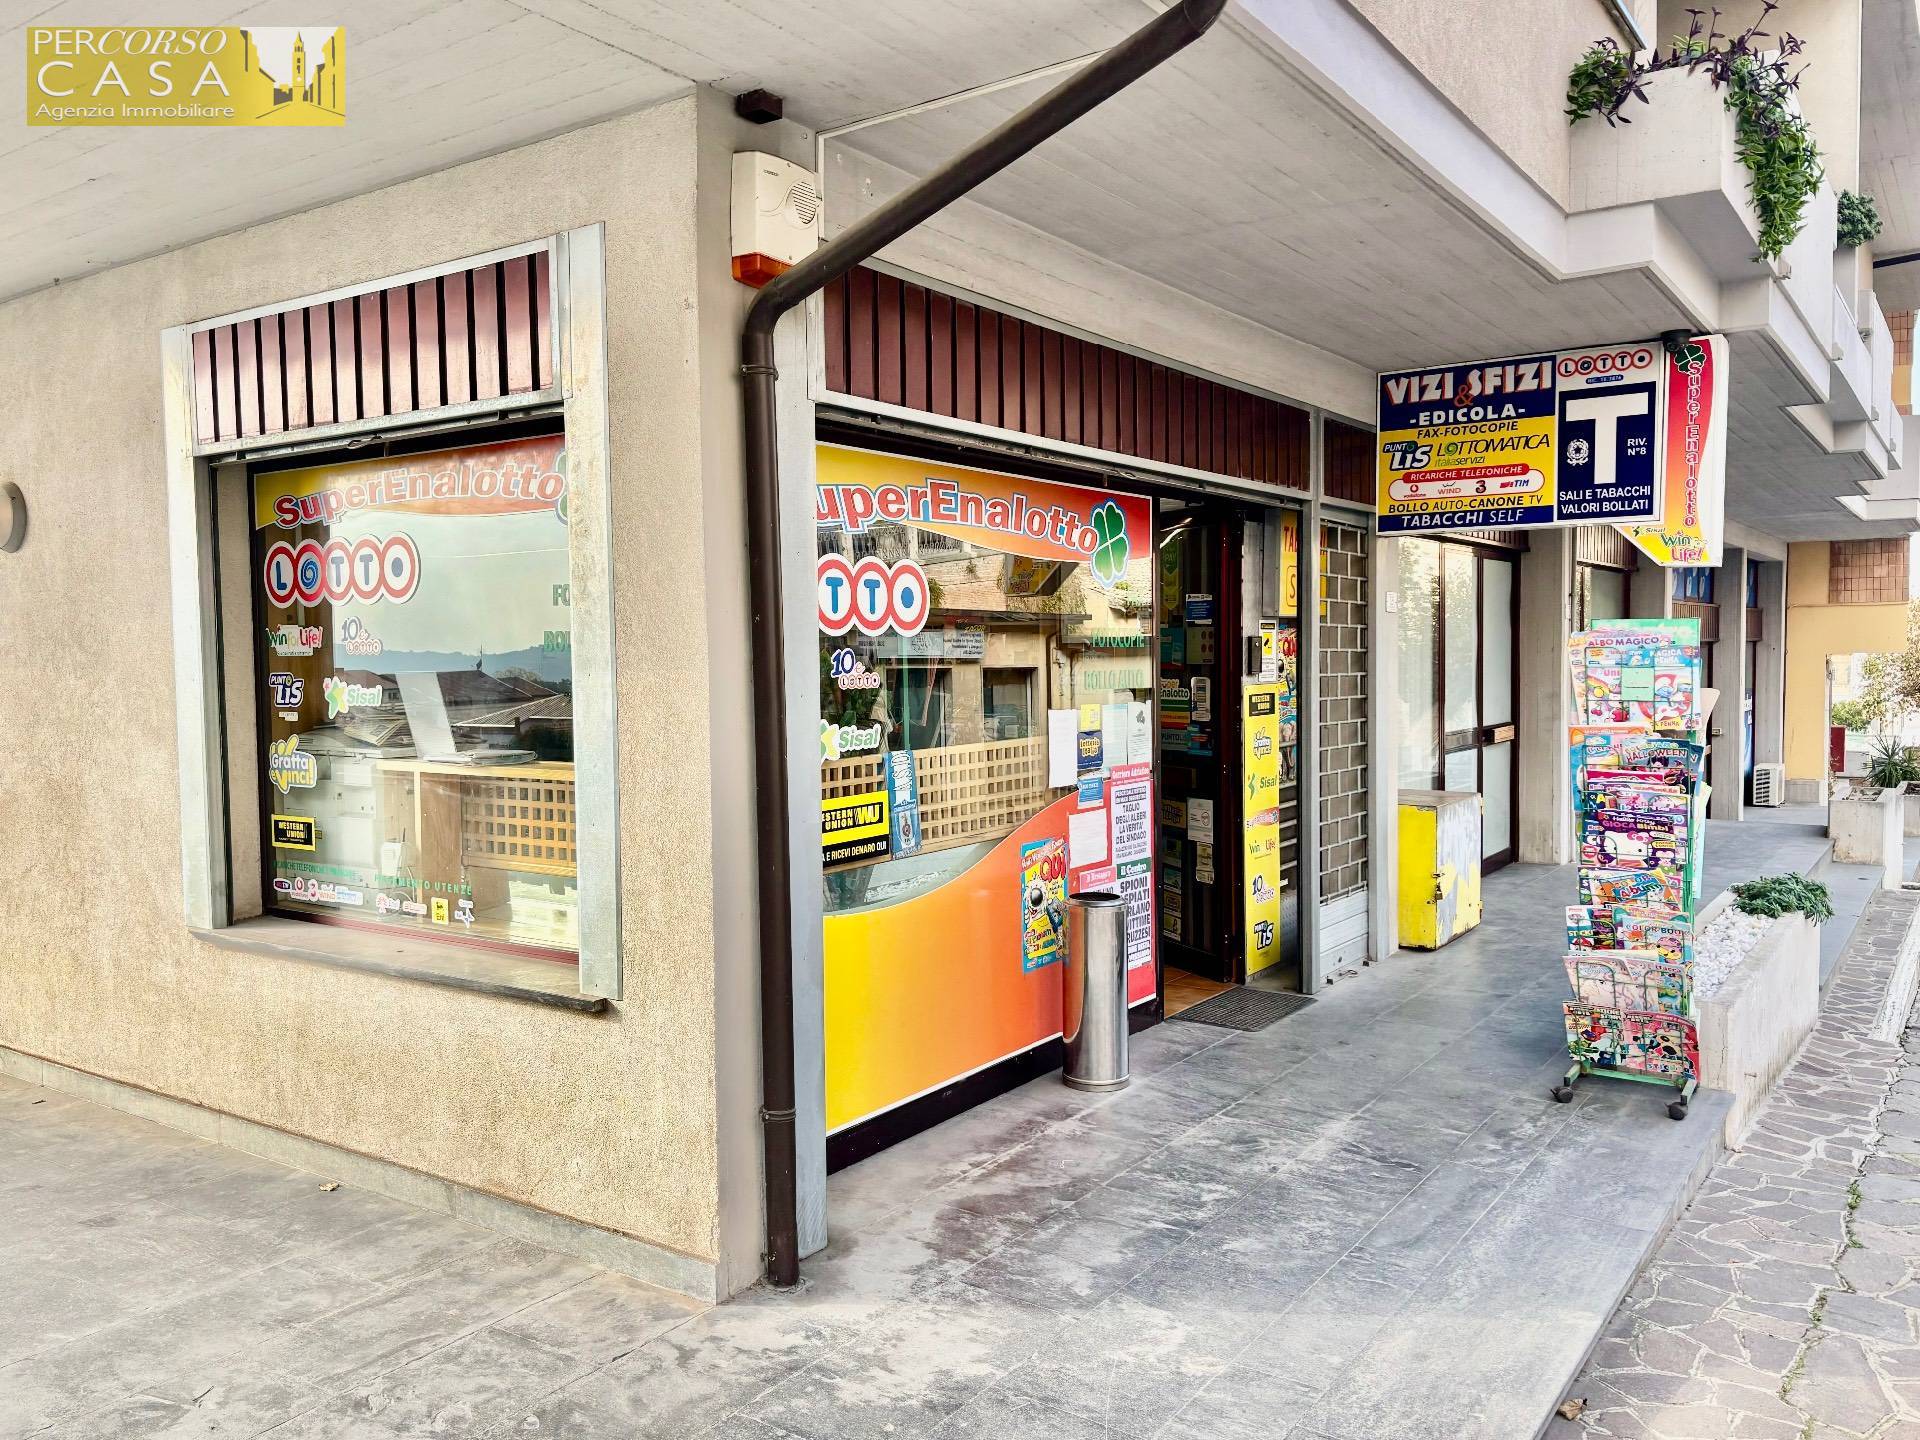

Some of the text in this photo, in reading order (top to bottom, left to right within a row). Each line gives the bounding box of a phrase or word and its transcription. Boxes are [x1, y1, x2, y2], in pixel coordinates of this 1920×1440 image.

[1559, 350, 1651, 376] LOTTO
[1386, 361, 1552, 407] VIZI & SFIZI
[1416, 421, 1519, 439] FAX-FOTOCOPIE
[1566, 391, 1648, 485] T
[1384, 442, 1416, 452] PUNTO
[1437, 433, 1550, 457] LOTTOMATICA
[1627, 437, 1648, 447] RIV.
[1685, 362, 1701, 526] SuperEnalotto
[1627, 446, 1647, 456] N°8
[1410, 465, 1523, 481] RICARICHE TELEFONICHE
[1437, 487, 1462, 495] WIND
[1475, 480, 1487, 494] 3
[1513, 479, 1530, 488] TIM
[274, 463, 563, 528] SuperEnalotto
[1559, 486, 1651, 500] SALI E TABACCHI
[1388, 494, 1544, 514] BOLLO AUTO-CANONE TV
[1561, 500, 1649, 514] VALORI BOLLATI
[1402, 509, 1525, 528] TABACCHI SELF
[1284, 526, 1297, 552] TA
[1660, 530, 1691, 547] Win
[1671, 546, 1704, 562] Life!
[269, 541, 412, 600] LOTTO
[300, 626, 323, 648] Life!
[341, 616, 360, 642] 10
[1588, 636, 1659, 647] ALBO MAGICO
[831, 650, 855, 676] 10
[840, 674, 880, 689] LOTTO
[348, 685, 382, 706] Sisal
[839, 727, 879, 749] Sisal
[271, 754, 309, 770] Gratta
[1260, 774, 1277, 789] Sisal
[1123, 803, 1140, 813] TAGLIO
[278, 821, 304, 831] WESTERN
[825, 818, 854, 831] UNION
[1115, 815, 1130, 825] DEGLI
[1119, 825, 1126, 834] LA
[1115, 831, 1147, 845] DEL SINDACO
[826, 852, 831, 861] E
[831, 848, 851, 861] RICEVI
[851, 843, 876, 856] DENARO
[876, 841, 887, 851] QUI
[434, 881, 472, 896] UTENZE
[1120, 876, 1148, 894] SPIONI
[1252, 875, 1263, 895] 10
